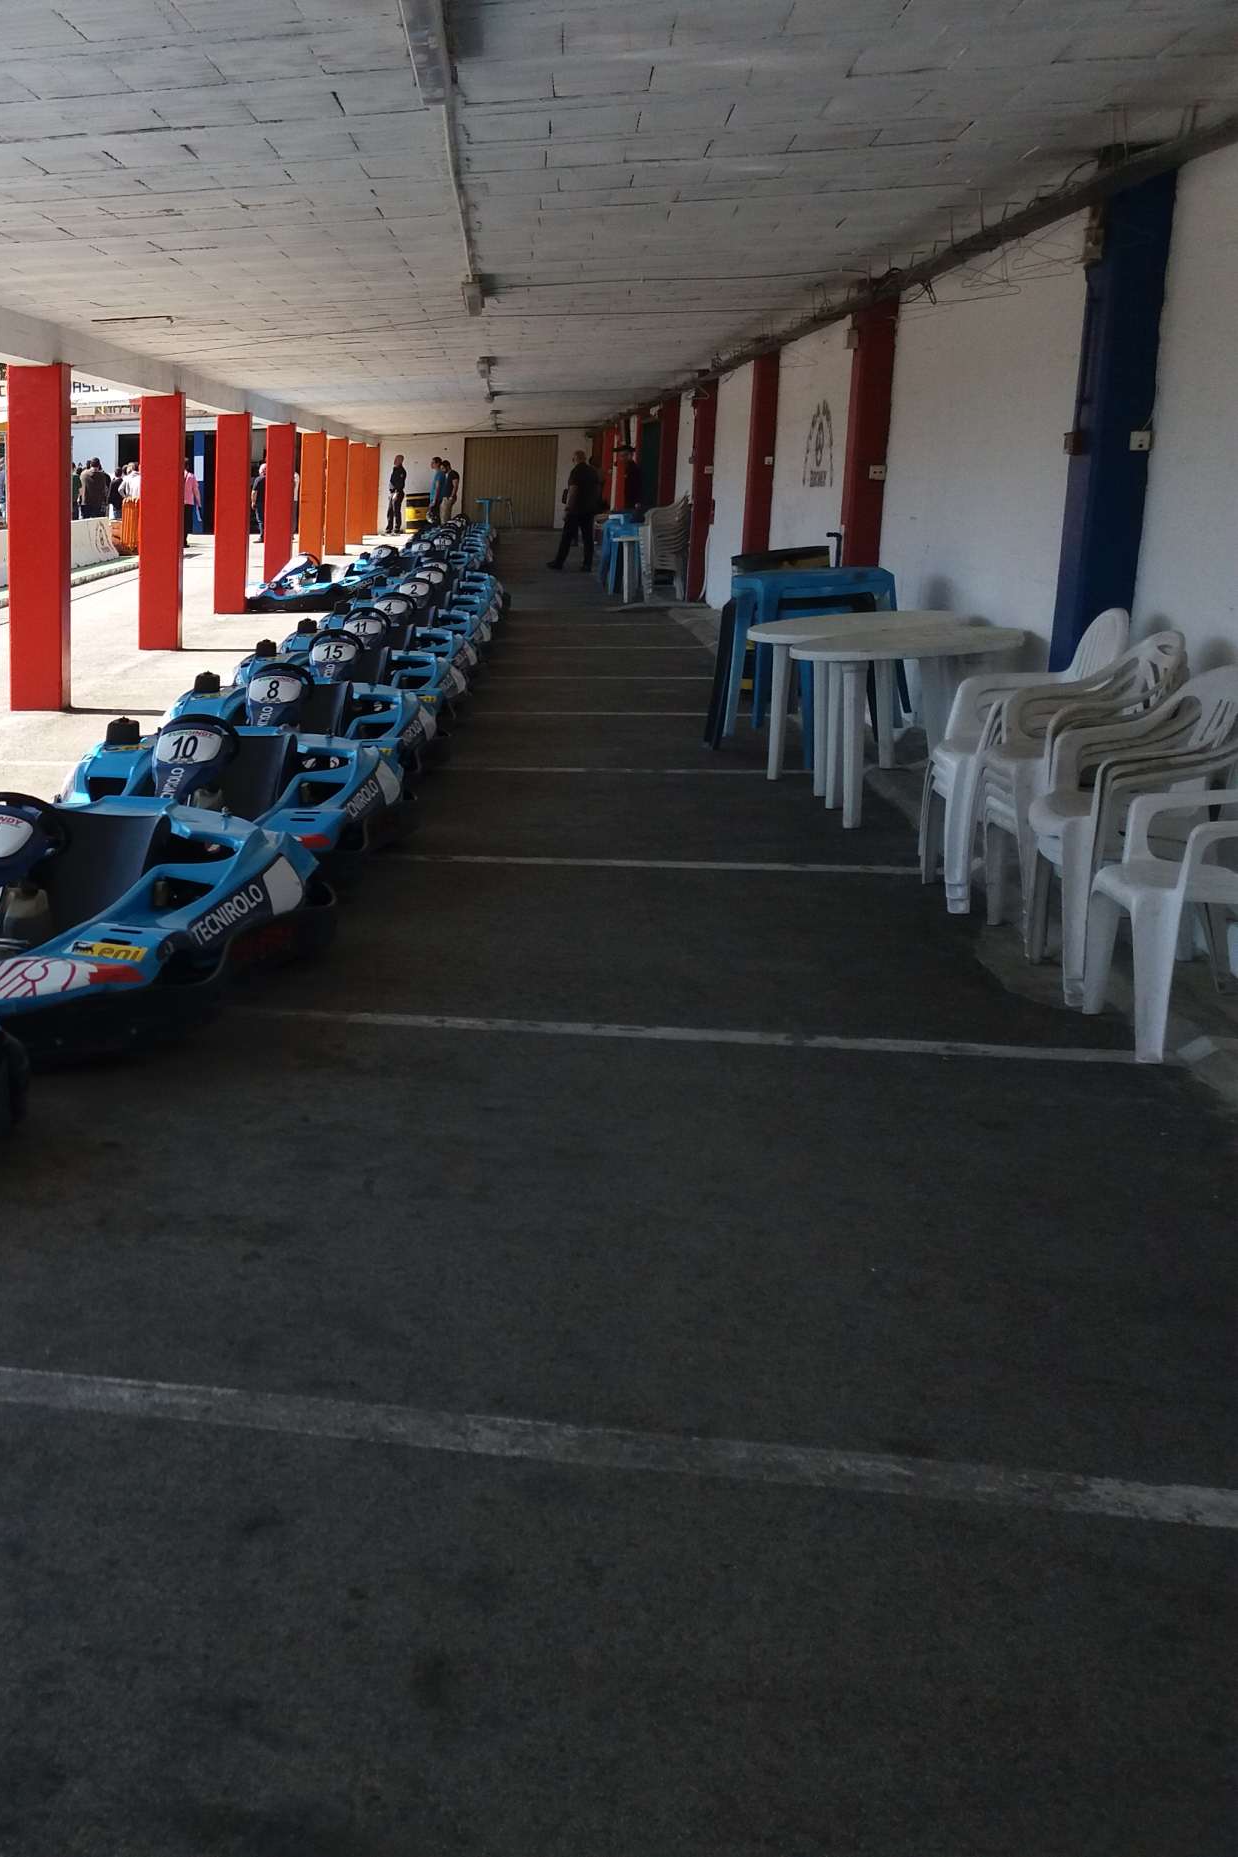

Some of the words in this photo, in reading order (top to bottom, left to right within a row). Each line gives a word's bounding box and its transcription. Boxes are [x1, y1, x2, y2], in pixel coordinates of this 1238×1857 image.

[410, 584, 417, 594] 2
[384, 602, 393, 613] 4
[354, 622, 367, 633] 11
[324, 645, 344, 660] 15
[267, 680, 280, 699] 8
[172, 736, 199, 759] 10
[191, 883, 264, 946] TECNIROLO
